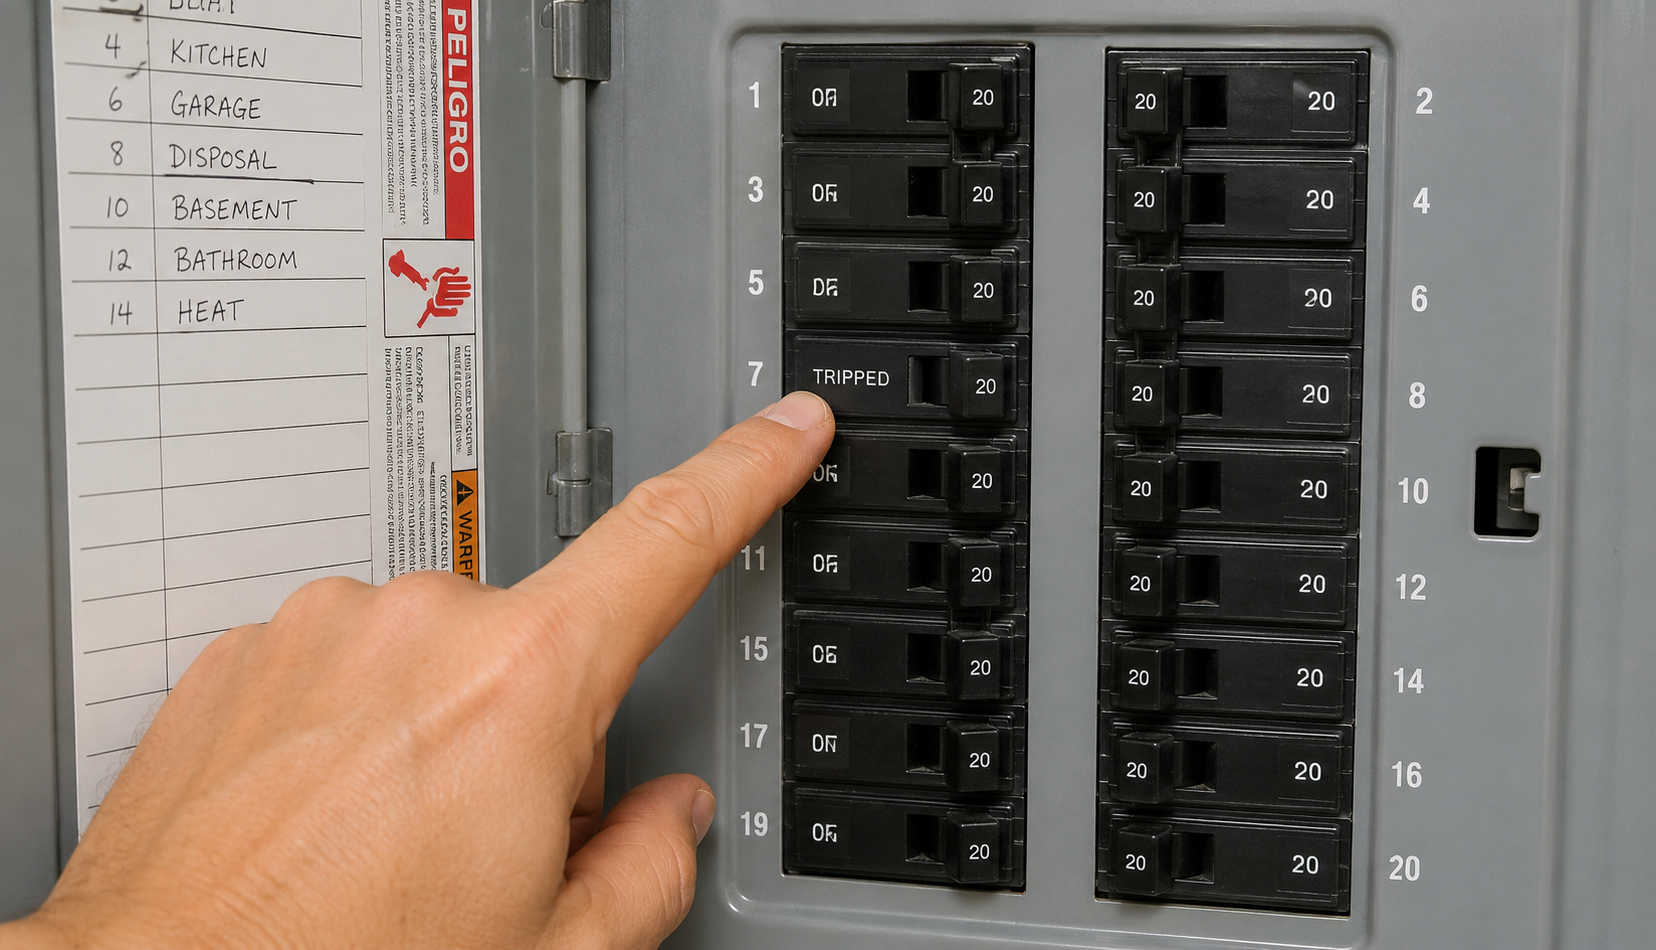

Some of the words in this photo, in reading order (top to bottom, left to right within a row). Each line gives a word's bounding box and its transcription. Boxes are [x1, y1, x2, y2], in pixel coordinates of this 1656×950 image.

[105, 34, 120, 58] 4
[171, 39, 266, 68] KITCHEN
[447, 7, 469, 174] PELIGRO
[749, 82, 759, 108] 1
[973, 89, 993, 105] 20
[109, 87, 122, 111] 6
[172, 90, 260, 120] GARAGE
[1135, 93, 1156, 109] 20
[1308, 91, 1335, 110] 20
[1416, 87, 1432, 114] 2
[111, 141, 123, 165] 8
[169, 144, 277, 170] DISPOSAL
[749, 176, 763, 202] 3
[973, 186, 993, 202] 20
[108, 198, 128, 218] 10
[172, 195, 297, 220] BASEMENT
[1134, 192, 1154, 207] 20
[1307, 190, 1333, 209] 20
[1413, 187, 1430, 213] 4
[109, 249, 131, 271] 12
[174, 247, 297, 272] BATHROOM
[749, 270, 764, 295] 5
[974, 283, 993, 298] 20
[1134, 290, 1154, 306] 20
[1305, 288, 1331, 308] 20
[1412, 285, 1427, 312] 6
[111, 302, 132, 325] 14
[179, 299, 244, 324] HEAT
[748, 361, 763, 386] 7
[813, 369, 889, 386] TRIPPED
[976, 379, 996, 394] 20
[1132, 386, 1152, 402] 20
[1303, 384, 1329, 404] 20
[1409, 382, 1425, 408] 8
[972, 473, 992, 488] 20
[1131, 480, 1151, 496] 20
[1301, 480, 1327, 498] 20
[1399, 478, 1428, 504] 10
[741, 545, 766, 571] 11
[972, 567, 991, 582] 20
[1130, 575, 1150, 591] 20
[1299, 574, 1325, 593] 20
[1396, 574, 1426, 600] 12
[741, 636, 768, 661] 15
[971, 660, 990, 675] 20
[1129, 669, 1149, 685] 20
[1297, 668, 1323, 687] 20
[1394, 668, 1424, 693] 14
[741, 723, 767, 748] 17
[970, 753, 990, 767] 20
[1127, 762, 1147, 778] 20
[1295, 762, 1321, 781] 20
[1392, 761, 1422, 788] 16
[741, 811, 768, 836] 19
[970, 844, 989, 859] 20
[1126, 854, 1145, 870] 20
[1292, 855, 1318, 874] 20
[1390, 855, 1419, 881] 20
